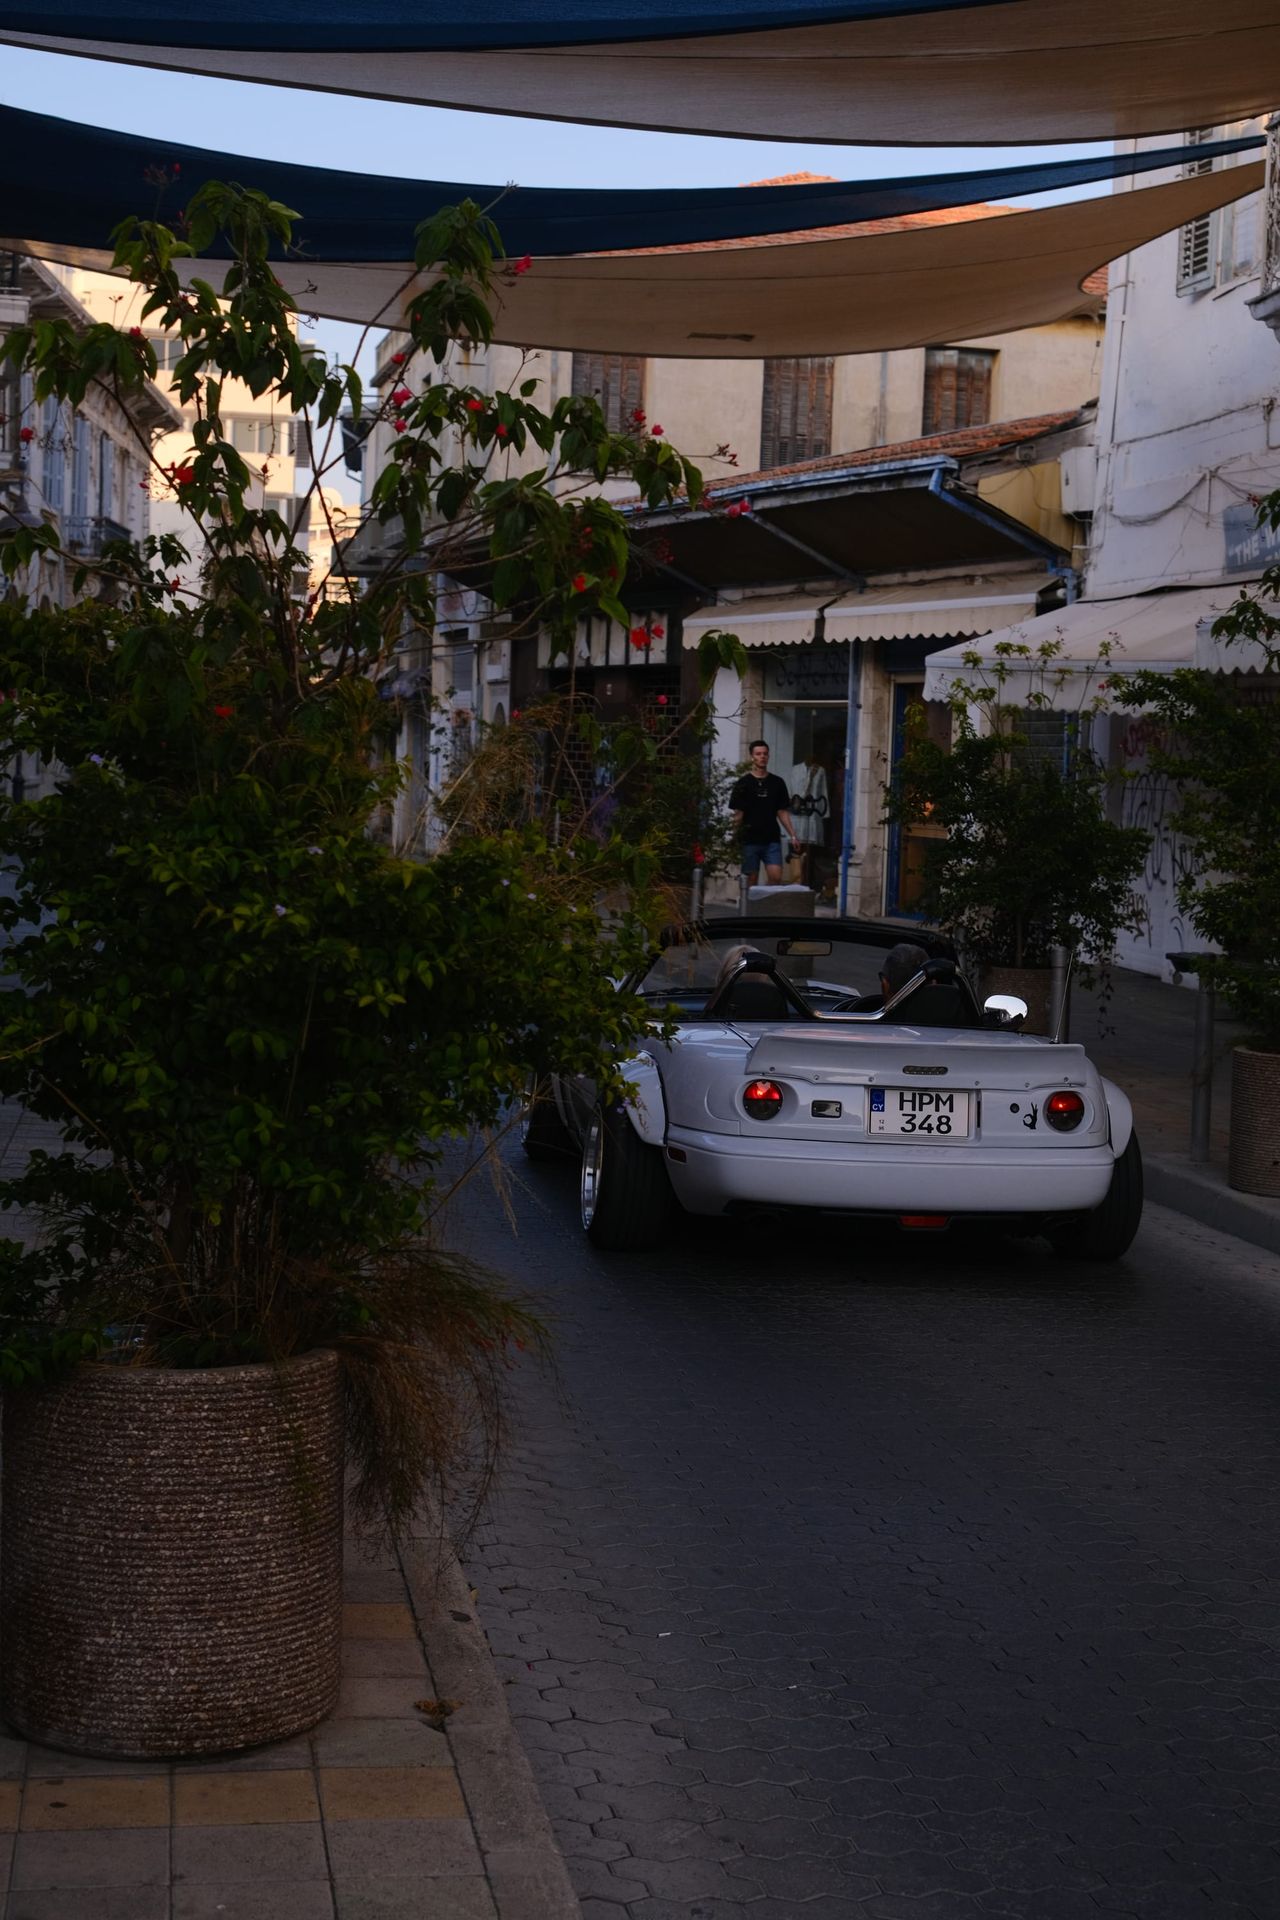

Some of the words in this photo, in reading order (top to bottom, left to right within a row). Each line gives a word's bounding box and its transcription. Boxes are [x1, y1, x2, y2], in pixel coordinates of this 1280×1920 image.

[871, 1103, 884, 1111] CY
[899, 1092, 954, 1112] HPM
[900, 1113, 952, 1135] 348
